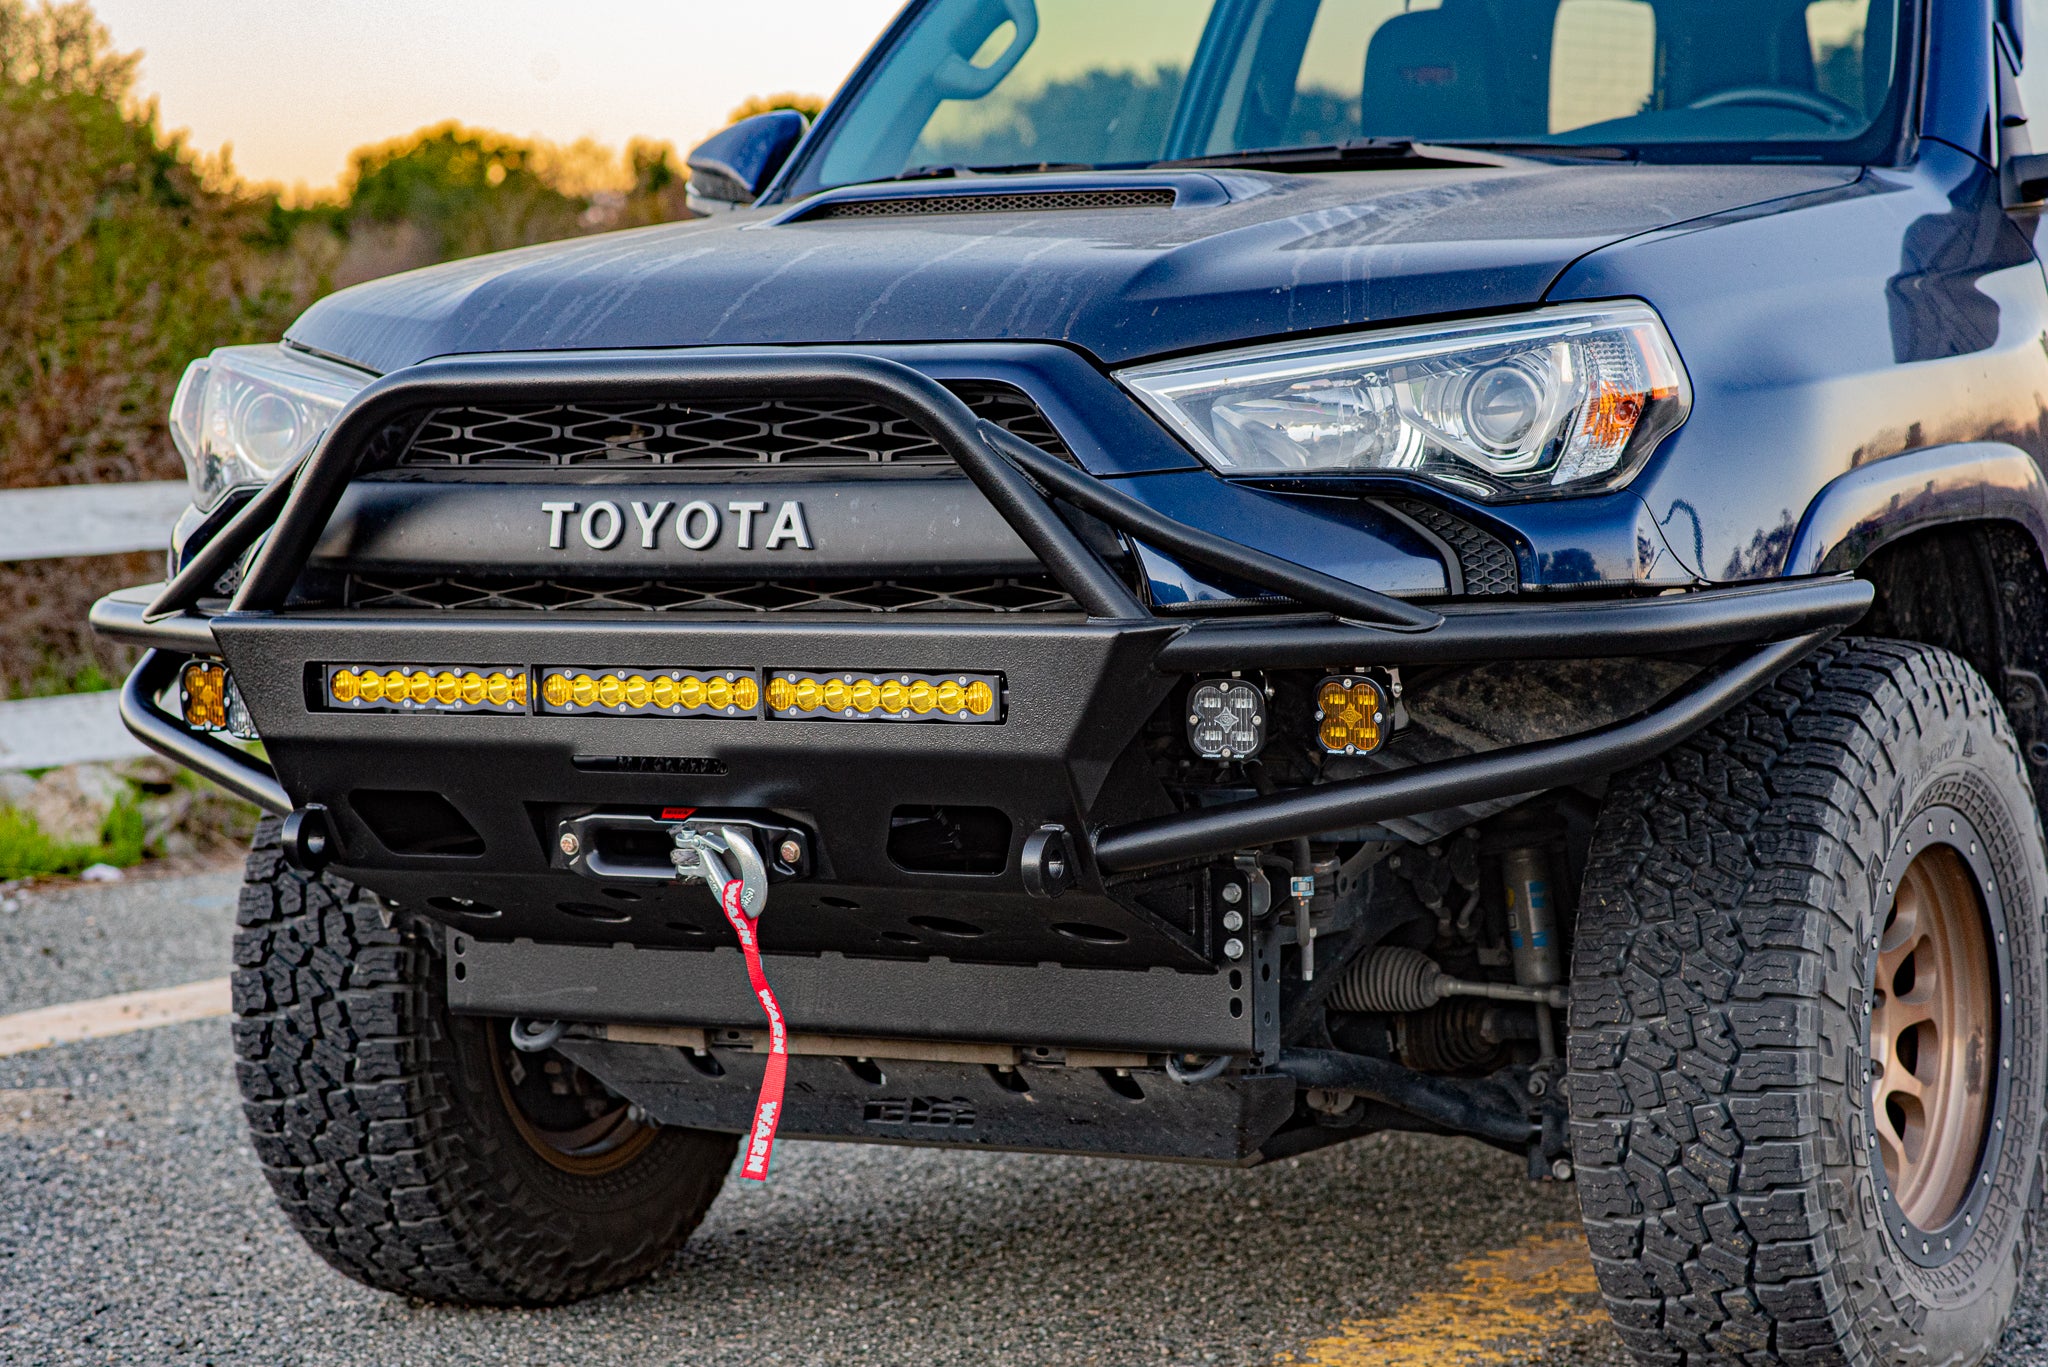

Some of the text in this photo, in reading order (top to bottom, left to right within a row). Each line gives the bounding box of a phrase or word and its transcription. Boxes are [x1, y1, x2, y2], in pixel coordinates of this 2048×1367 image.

[541, 500, 814, 551] TOYOTA
[724, 881, 753, 946] WARN
[758, 988, 785, 1055] WARN
[745, 1100, 779, 1175] WARN
